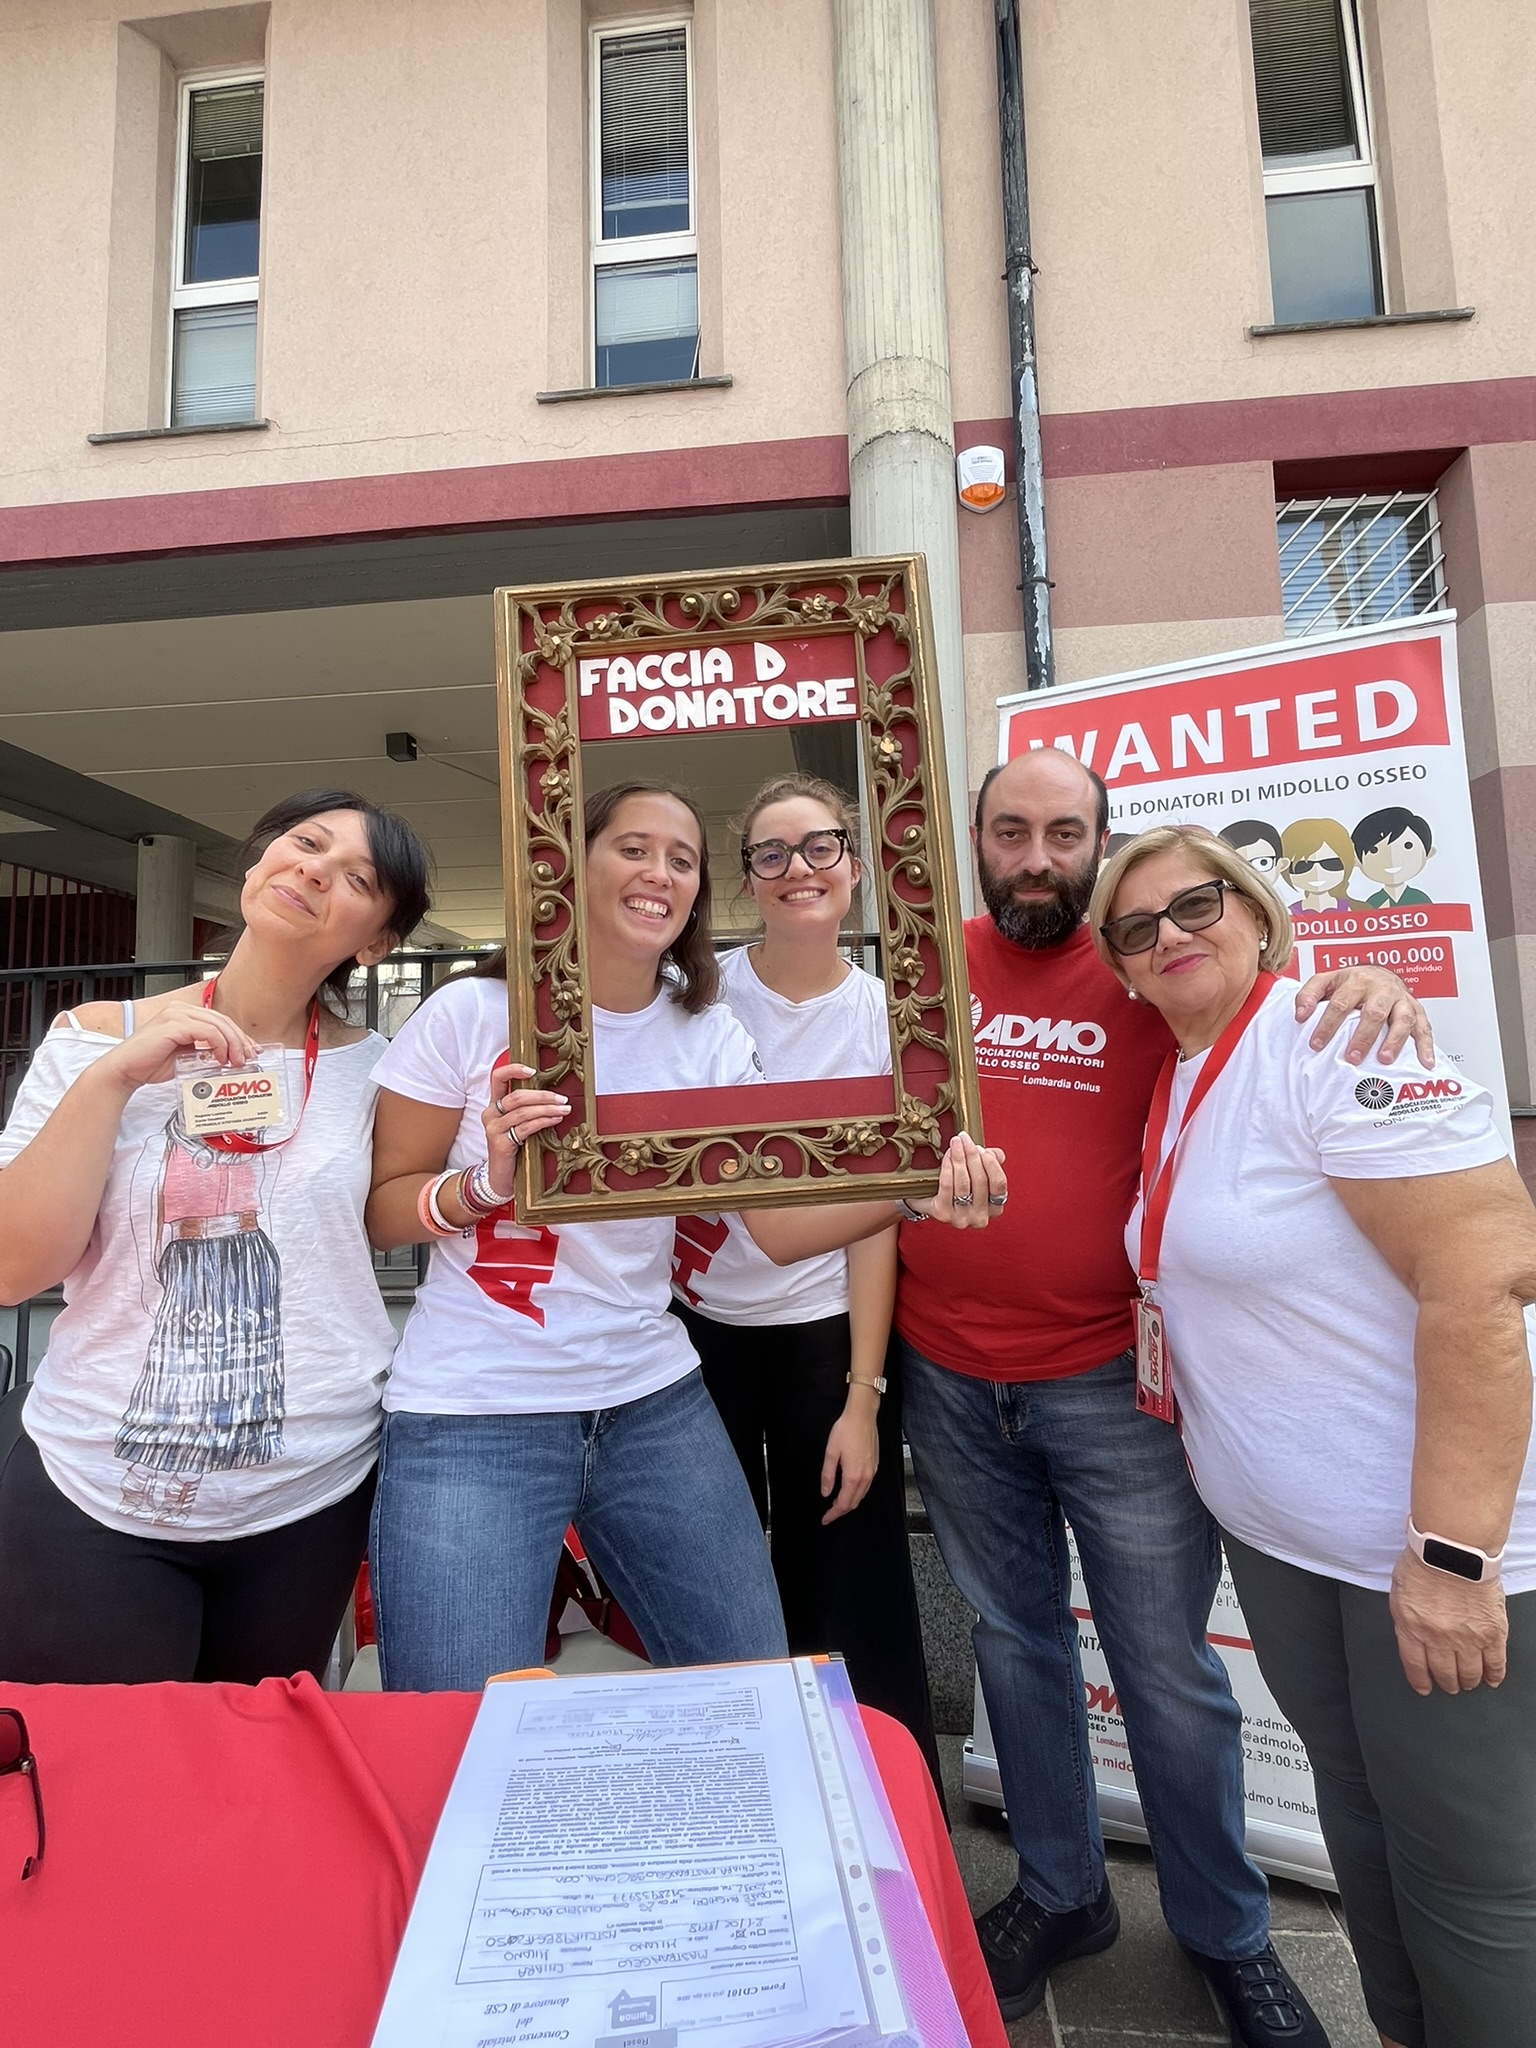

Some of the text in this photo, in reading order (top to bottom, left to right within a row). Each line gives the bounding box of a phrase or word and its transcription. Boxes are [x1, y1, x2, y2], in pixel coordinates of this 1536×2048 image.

[580, 642, 787, 697] FACCIA D
[609, 678, 857, 735] DONATORE
[1110, 764, 1428, 820] LI DONATORI DI MIDOLLO OSSEO
[1364, 912, 1429, 932] OSSEO
[1322, 953, 1331, 969] 1
[1366, 946, 1444, 967] 100.000
[1406, 964, 1443, 973] individuo
[974, 1013, 1107, 1055] ADMO
[974, 1046, 1105, 1068] SOCIAZIONE DONATORI
[1001, 1060, 1040, 1071] OSSEO
[214, 1079, 272, 1098] ADMO
[1022, 1075, 1101, 1093] Lombardia Onlus
[1395, 1079, 1462, 1103] ADMO
[1277, 1796, 1317, 1816] Lomba
[726, 1986, 758, 1997] CD101
[760, 1982, 786, 1992] Form
[483, 1996, 569, 2014] donatore di CSE
[515, 2016, 533, 2027] del
[476, 2028, 569, 2047] Consenso iniziale
